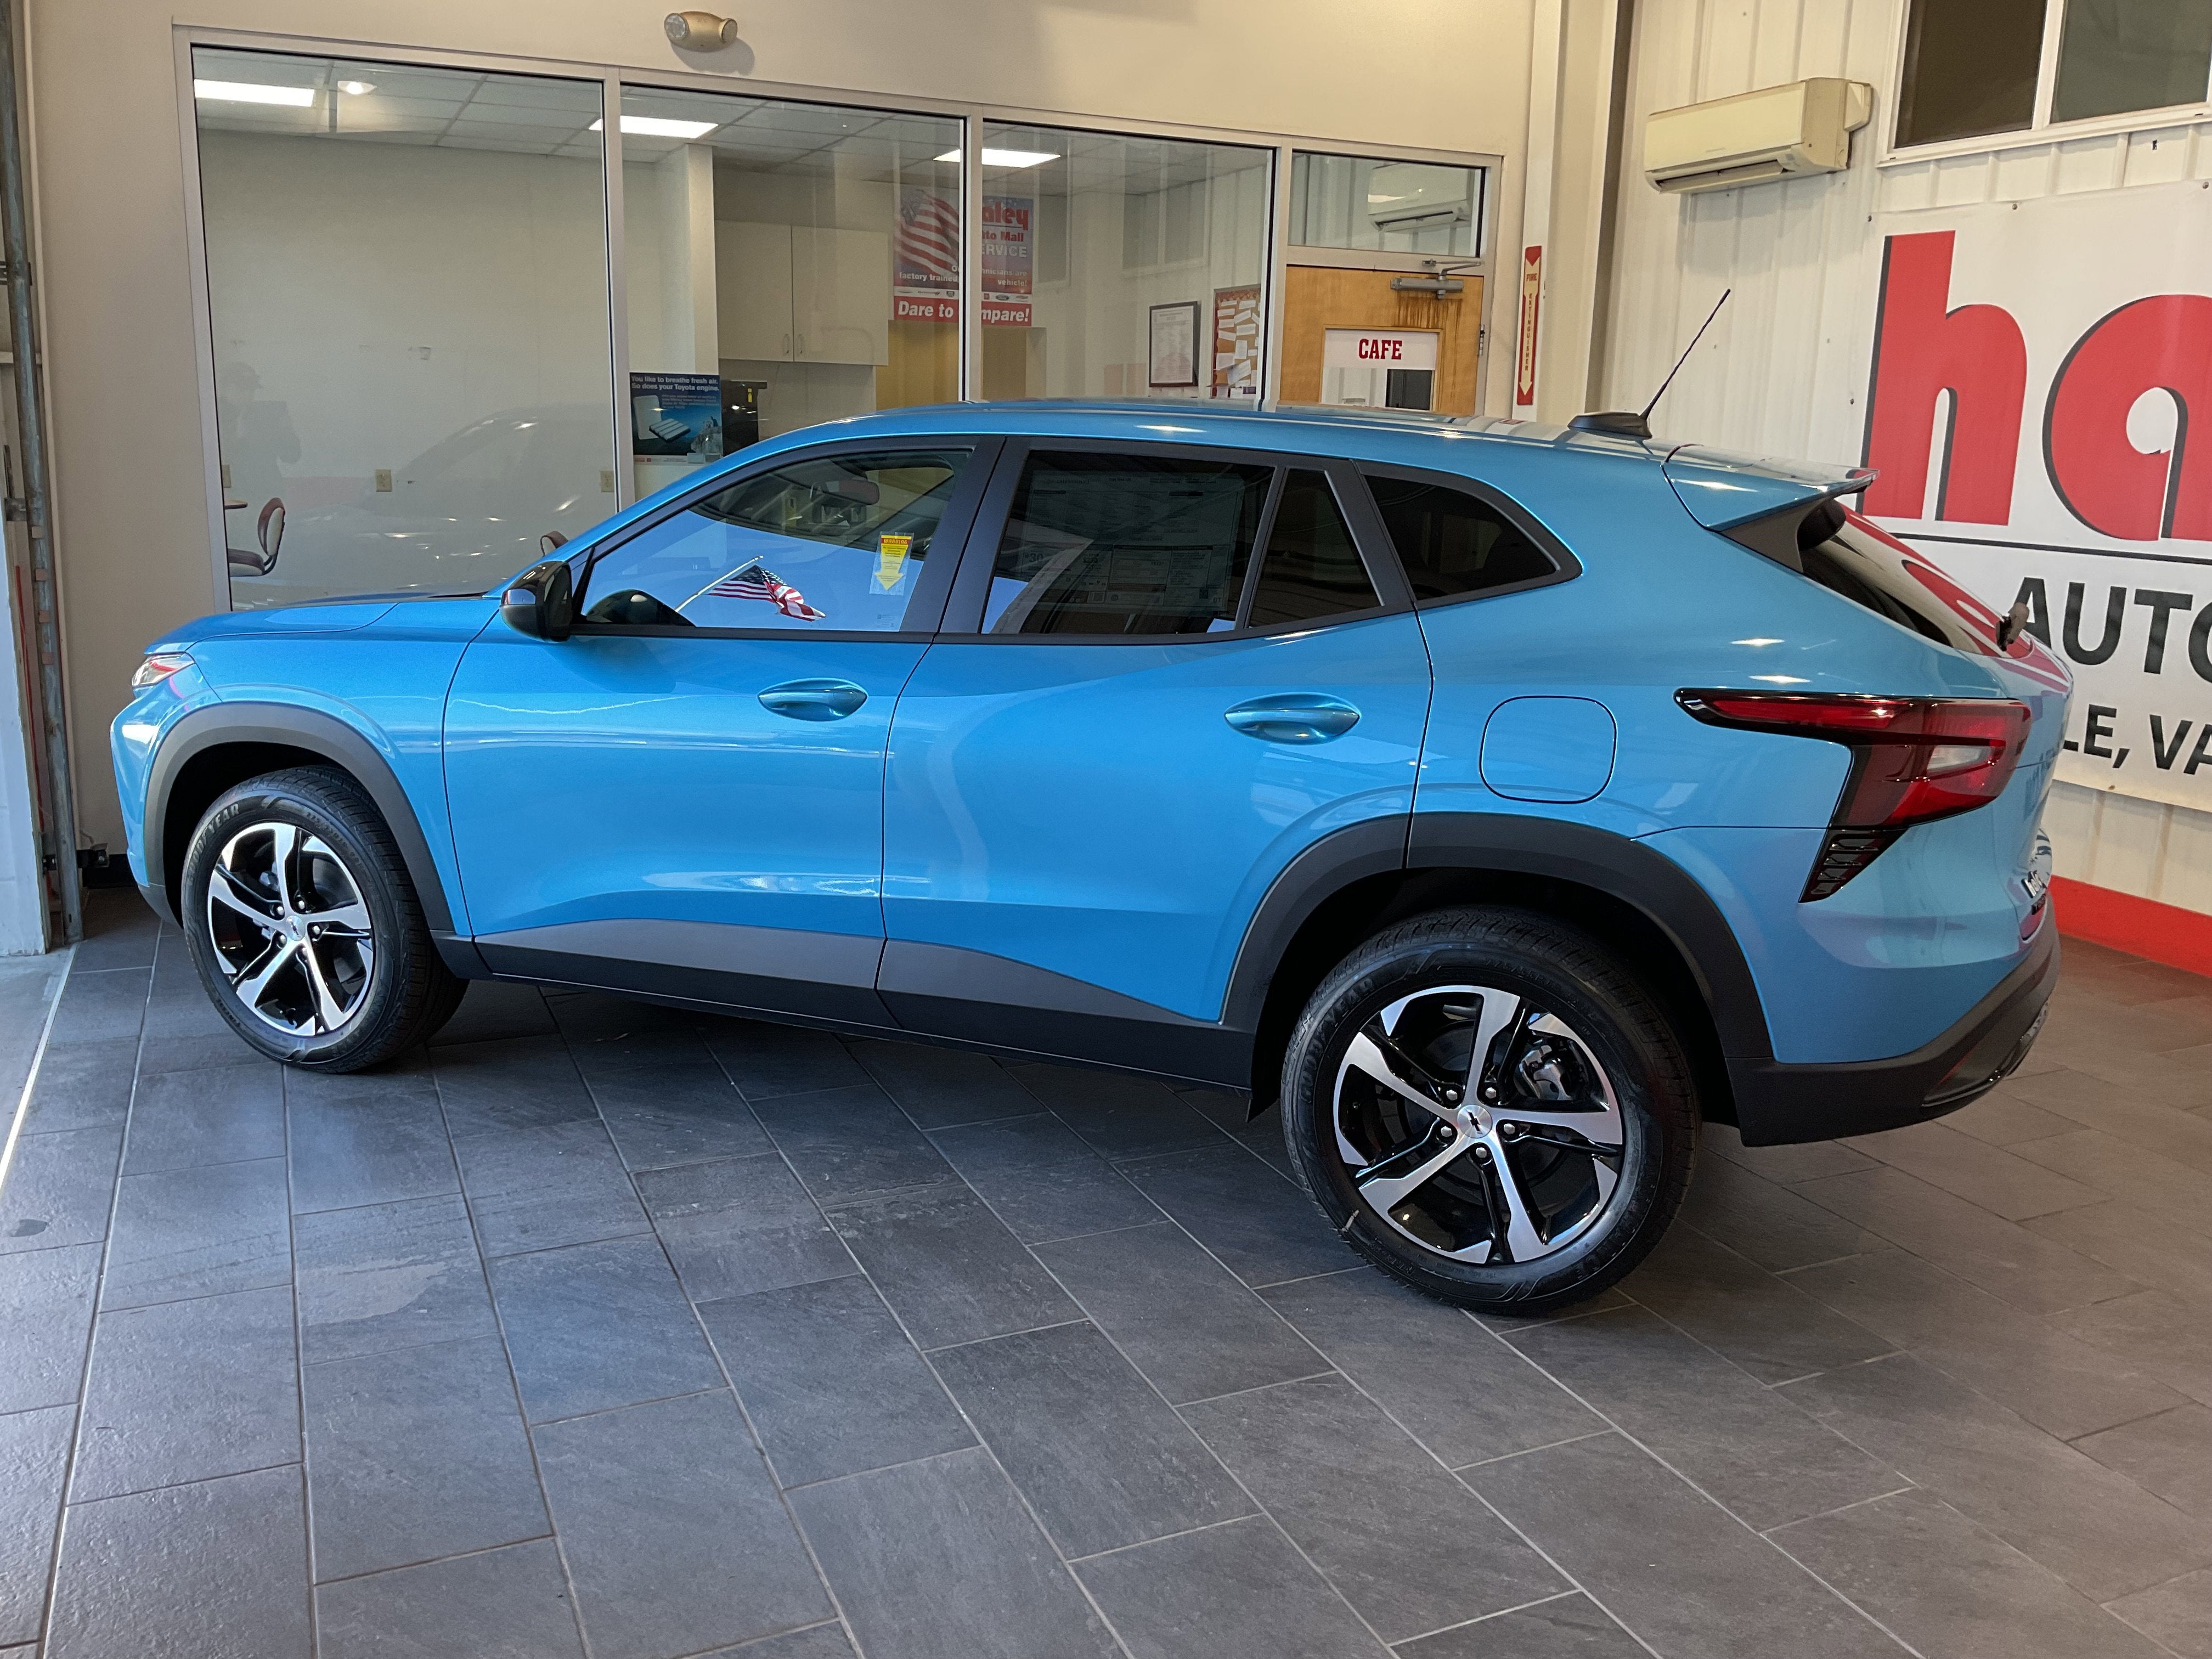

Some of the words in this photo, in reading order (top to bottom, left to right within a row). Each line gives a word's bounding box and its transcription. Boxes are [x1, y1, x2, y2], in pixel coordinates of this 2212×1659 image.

[1001, 231, 1024, 242] Mall
[899, 272, 927, 281] factory
[929, 274, 958, 282] trained
[1526, 273, 1538, 282] FIRE
[898, 301, 934, 317] Dare
[939, 303, 954, 318] to
[1358, 338, 1403, 360] CAFE
[1855, 230, 2212, 541] ha
